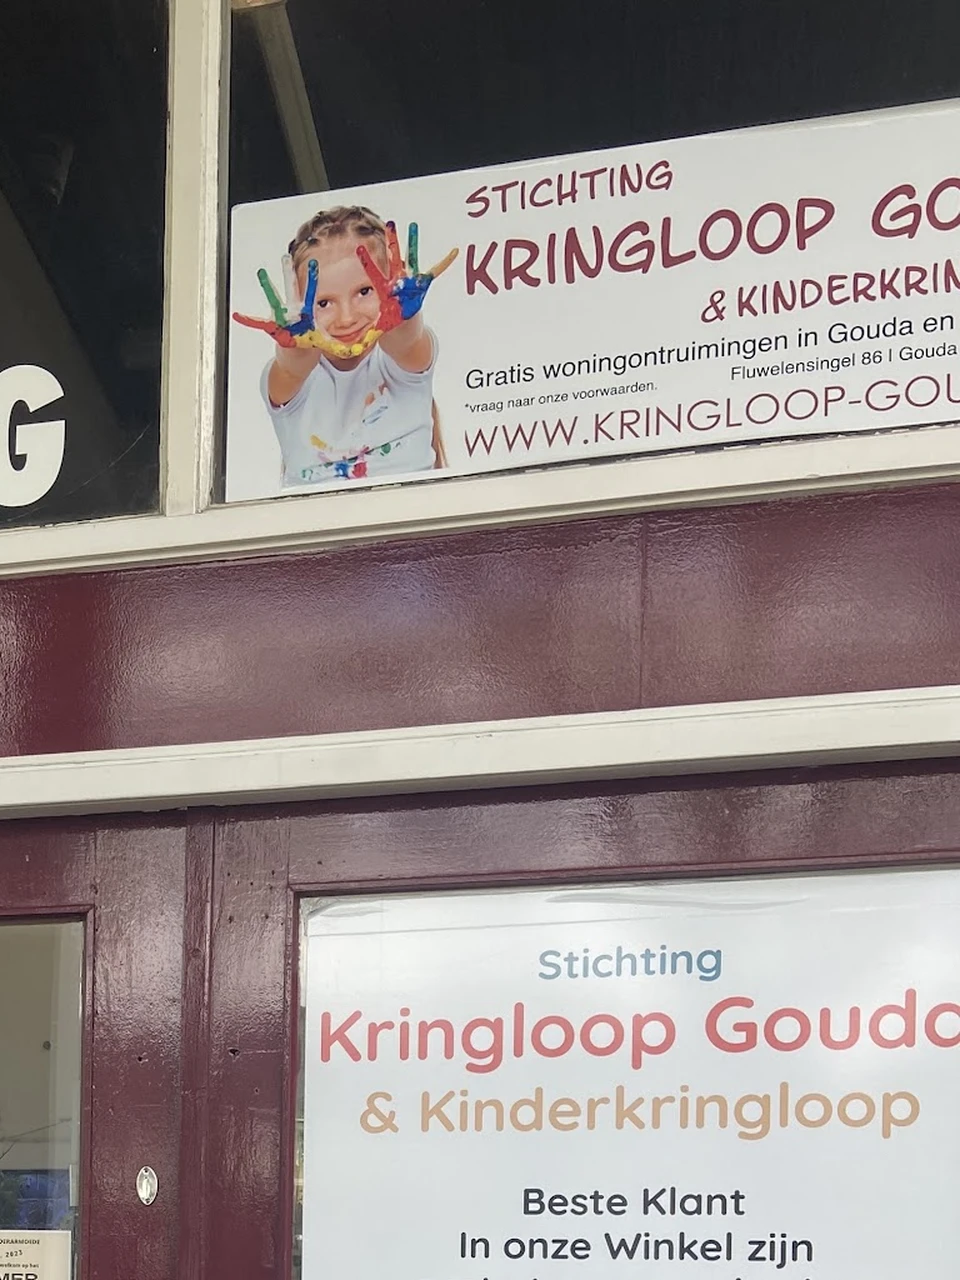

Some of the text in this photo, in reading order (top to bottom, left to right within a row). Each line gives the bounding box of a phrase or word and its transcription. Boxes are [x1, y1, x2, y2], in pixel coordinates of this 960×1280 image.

[465, 159, 675, 219] STICHTING
[465, 196, 836, 296] KRINGLOOP
[700, 290, 727, 323] &
[465, 314, 955, 390] Gratis woningontruimingen in Gouda en
[730, 352, 856, 382] Fluwelensingel
[861, 350, 883, 366] 86
[899, 341, 958, 361] Gouda
[507, 396, 535, 409] naar
[538, 392, 569, 405] onze
[572, 381, 658, 401] voorwaarden.
[538, 944, 724, 982] Stichting
[319, 1001, 677, 1074] Kringloop
[359, 1081, 921, 1140] & Kinderkringloop
[522, 1186, 746, 1216] Beste Klant
[459, 1231, 814, 1269] In onze Winkel zijn
